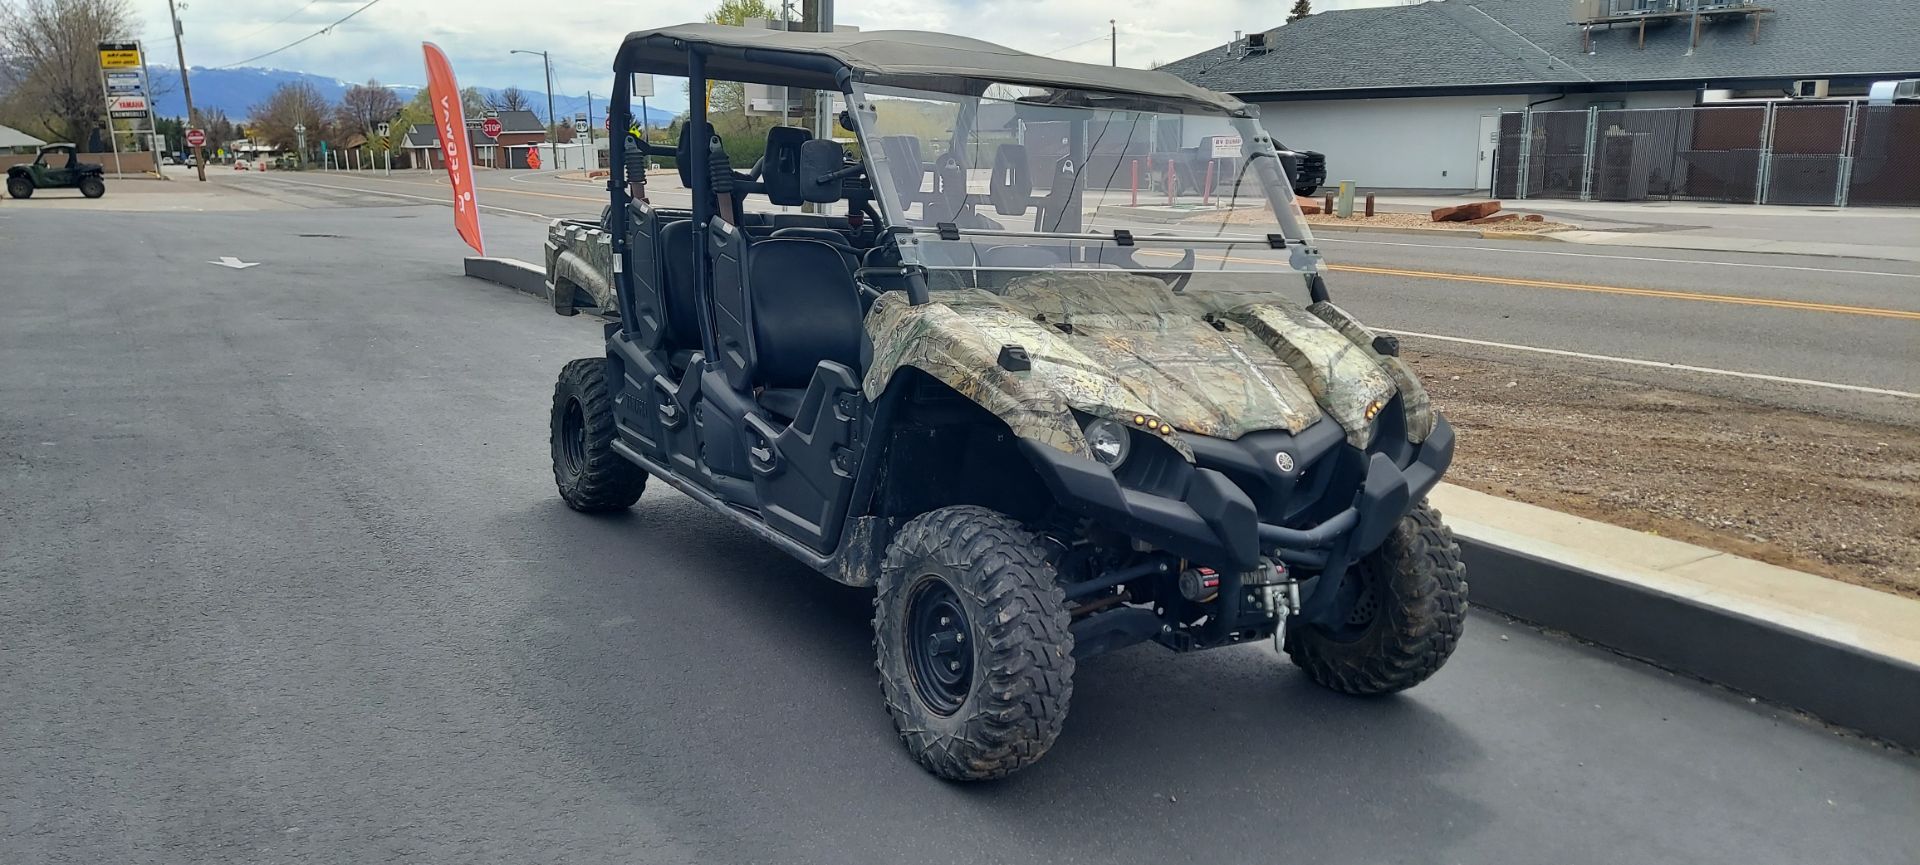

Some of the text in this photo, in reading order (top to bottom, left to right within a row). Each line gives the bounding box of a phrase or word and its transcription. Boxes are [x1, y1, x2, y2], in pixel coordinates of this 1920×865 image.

[119, 101, 144, 109] YAMAHA
[484, 123, 501, 132] STOP
[577, 122, 587, 130] 89
